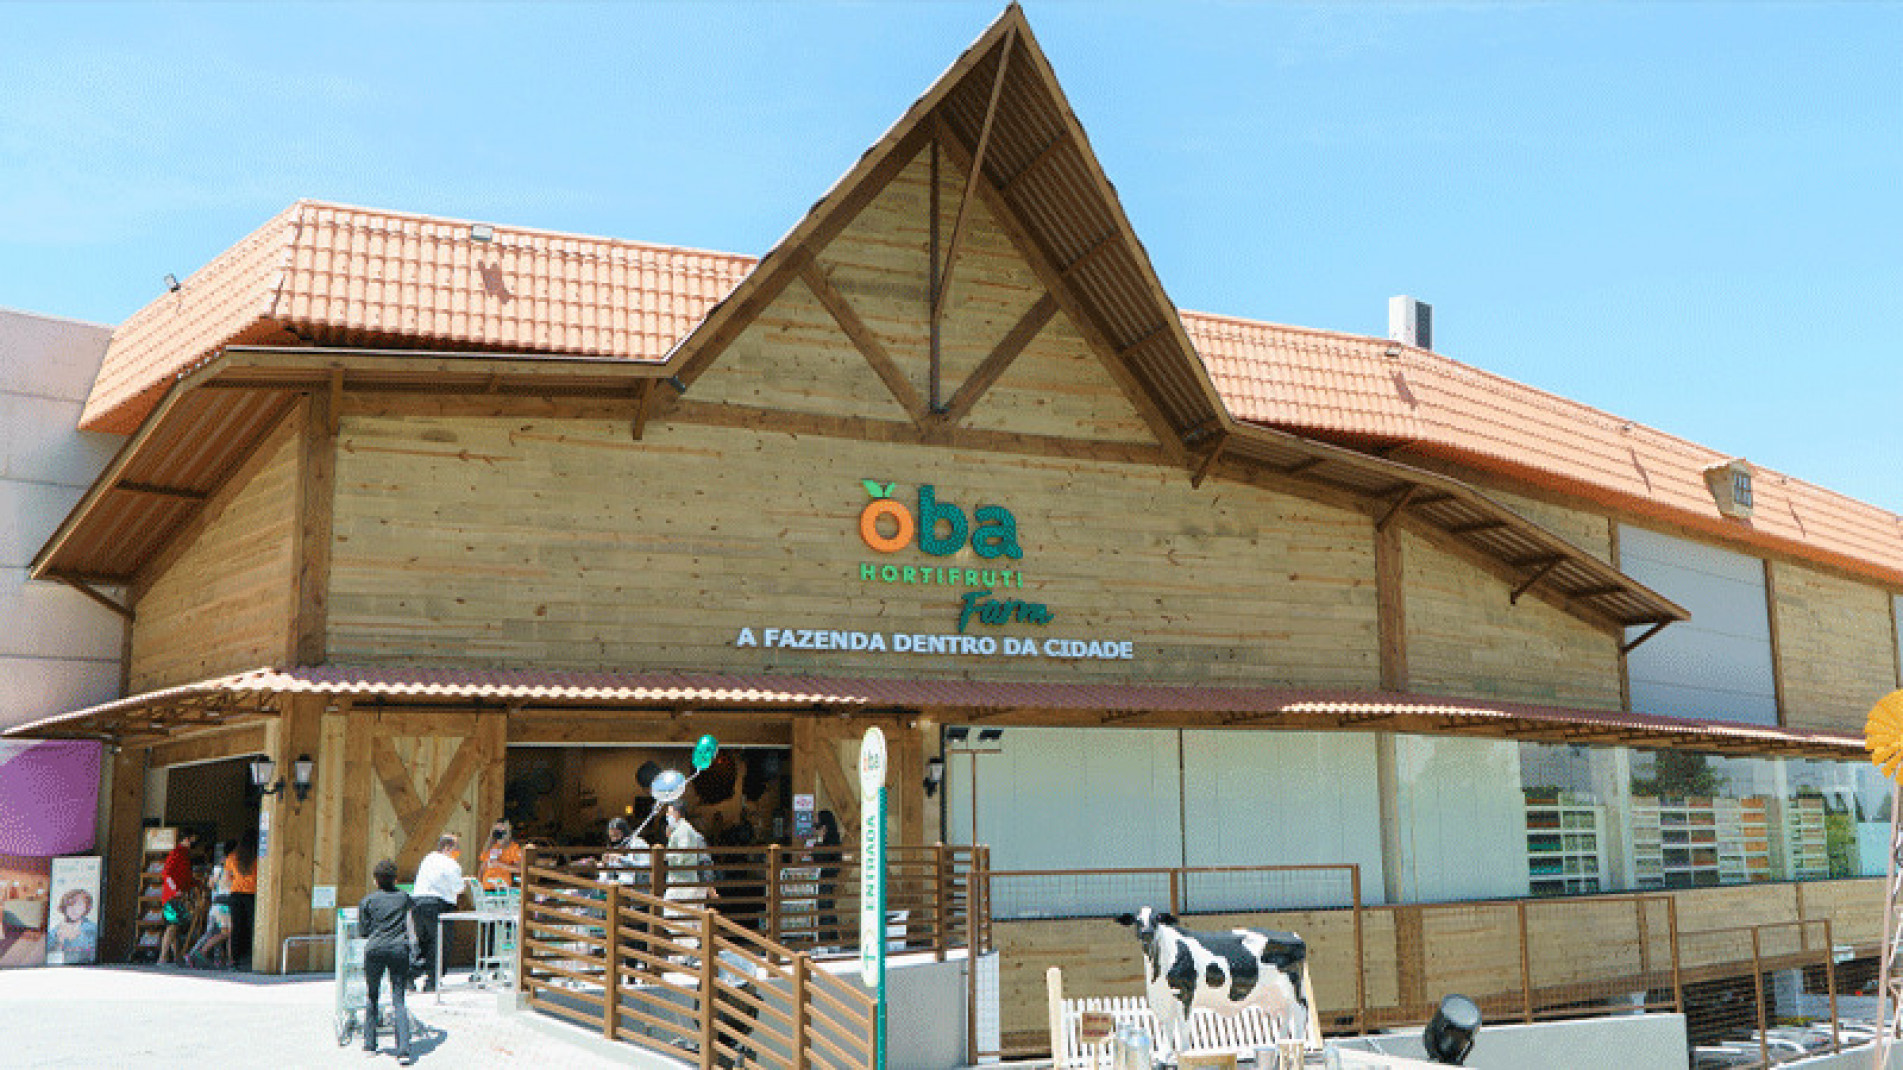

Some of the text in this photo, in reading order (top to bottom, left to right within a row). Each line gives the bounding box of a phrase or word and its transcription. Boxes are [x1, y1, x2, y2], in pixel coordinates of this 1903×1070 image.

[860, 483, 1024, 560] oba
[860, 563, 1024, 589] HORTIFRUTI
[957, 590, 1055, 633] Farm
[737, 627, 1133, 659] A FAZENDA DENTRO DA CIDADE
